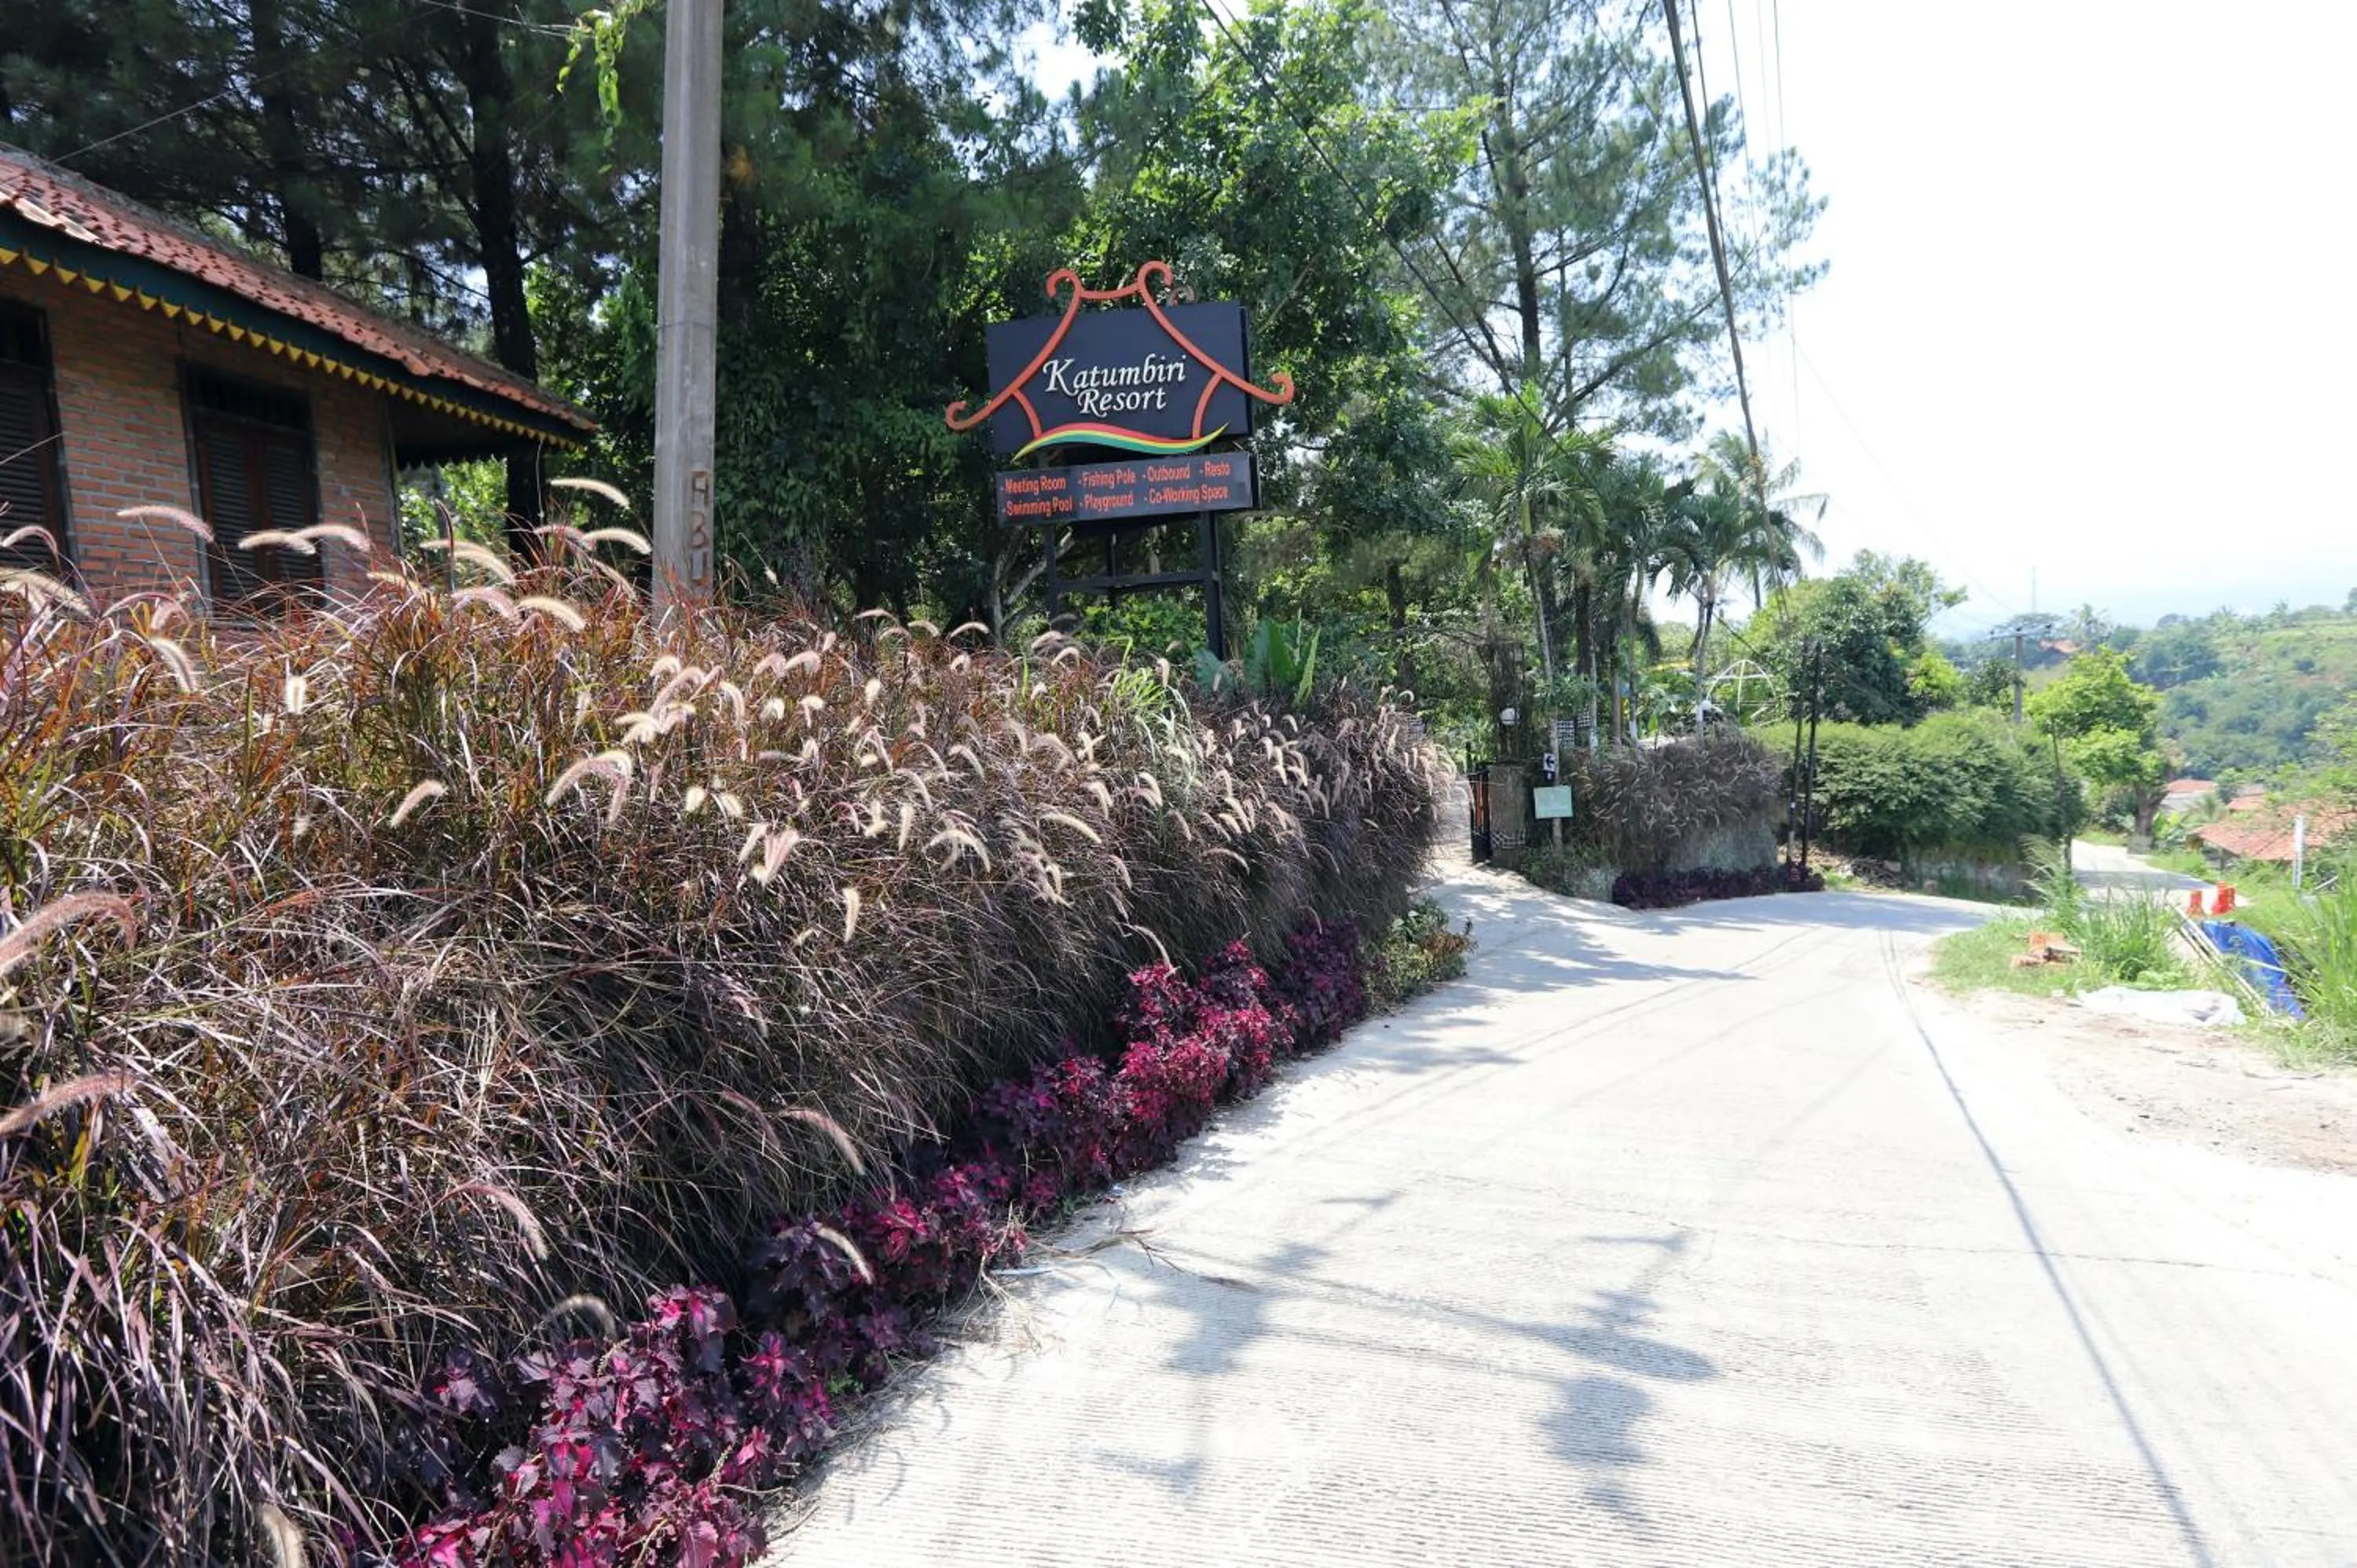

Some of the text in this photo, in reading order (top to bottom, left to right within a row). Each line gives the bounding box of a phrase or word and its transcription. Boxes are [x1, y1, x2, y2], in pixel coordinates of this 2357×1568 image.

[1043, 353, 1187, 397] Katumbiri
[1077, 387, 1167, 418] Resort
[1040, 474, 1066, 492] Room
[1116, 467, 1136, 485] Pole
[1200, 482, 1228, 503] Space
[1052, 496, 1072, 512] Pool
